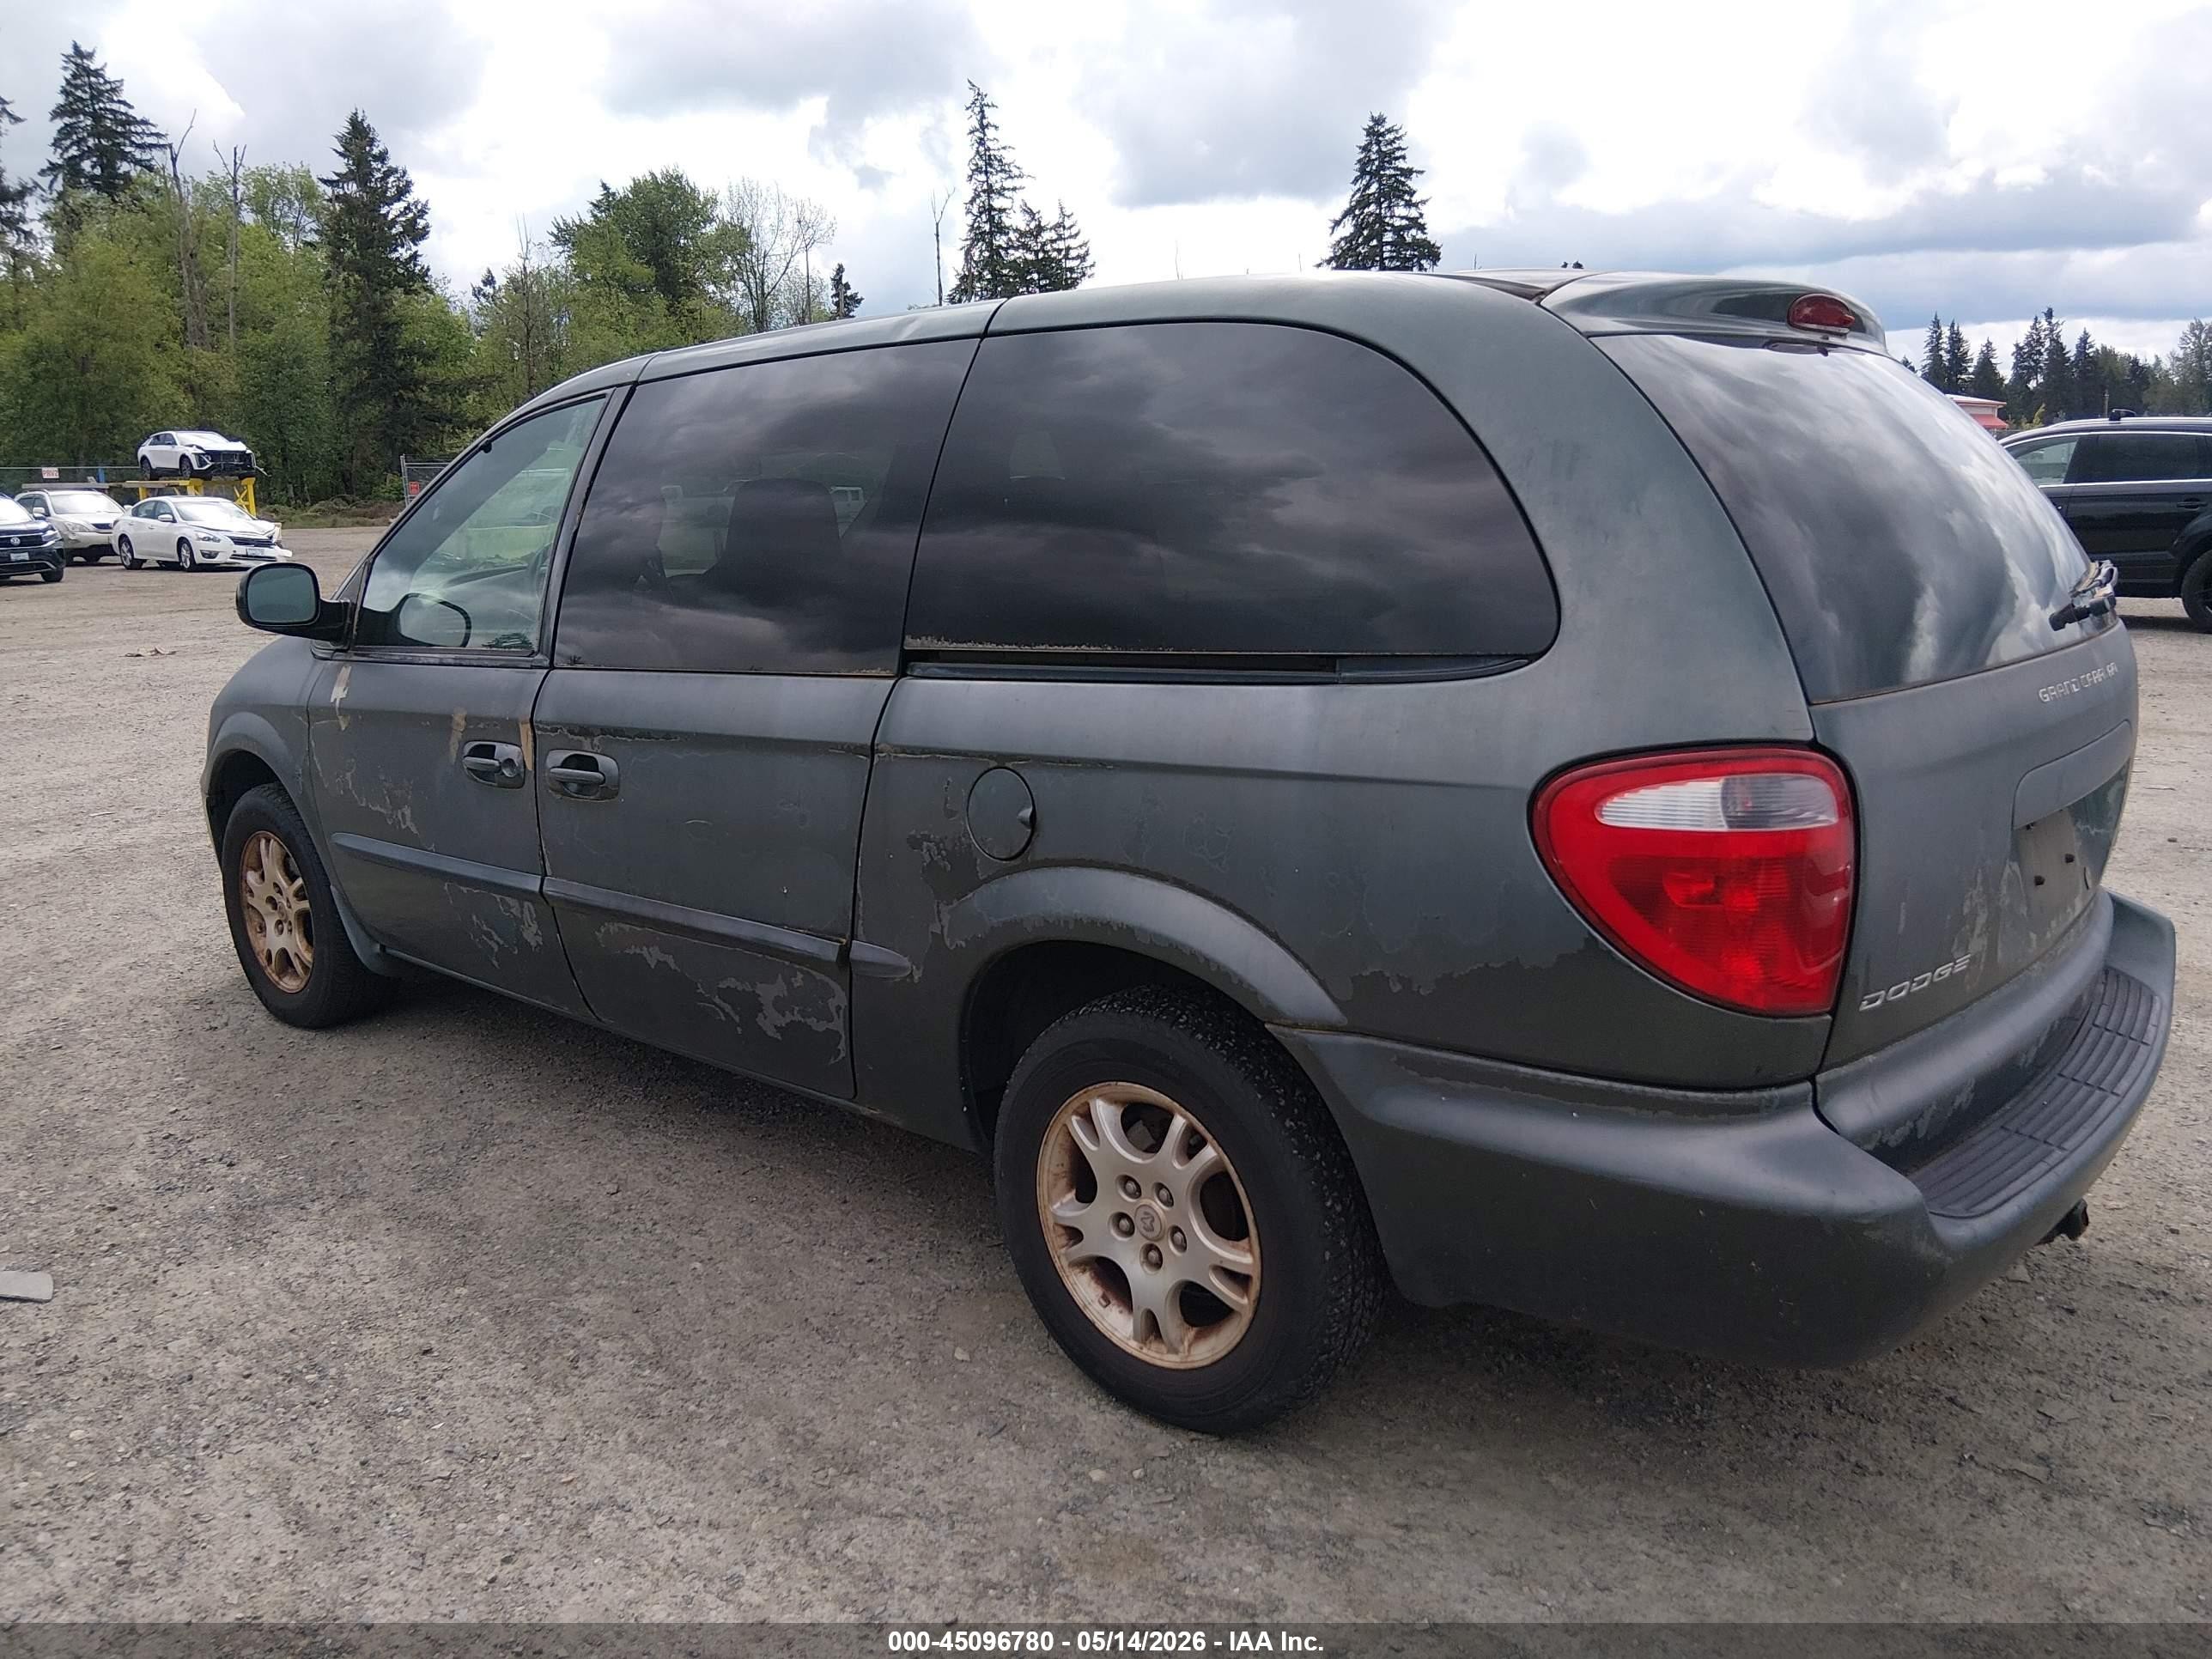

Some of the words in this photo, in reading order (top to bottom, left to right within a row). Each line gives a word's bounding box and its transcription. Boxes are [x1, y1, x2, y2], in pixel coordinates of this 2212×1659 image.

[2039, 678, 2080, 702] GRAND
[2080, 662, 2118, 688] CARAAN
[1858, 953, 1972, 1012] DODGE
